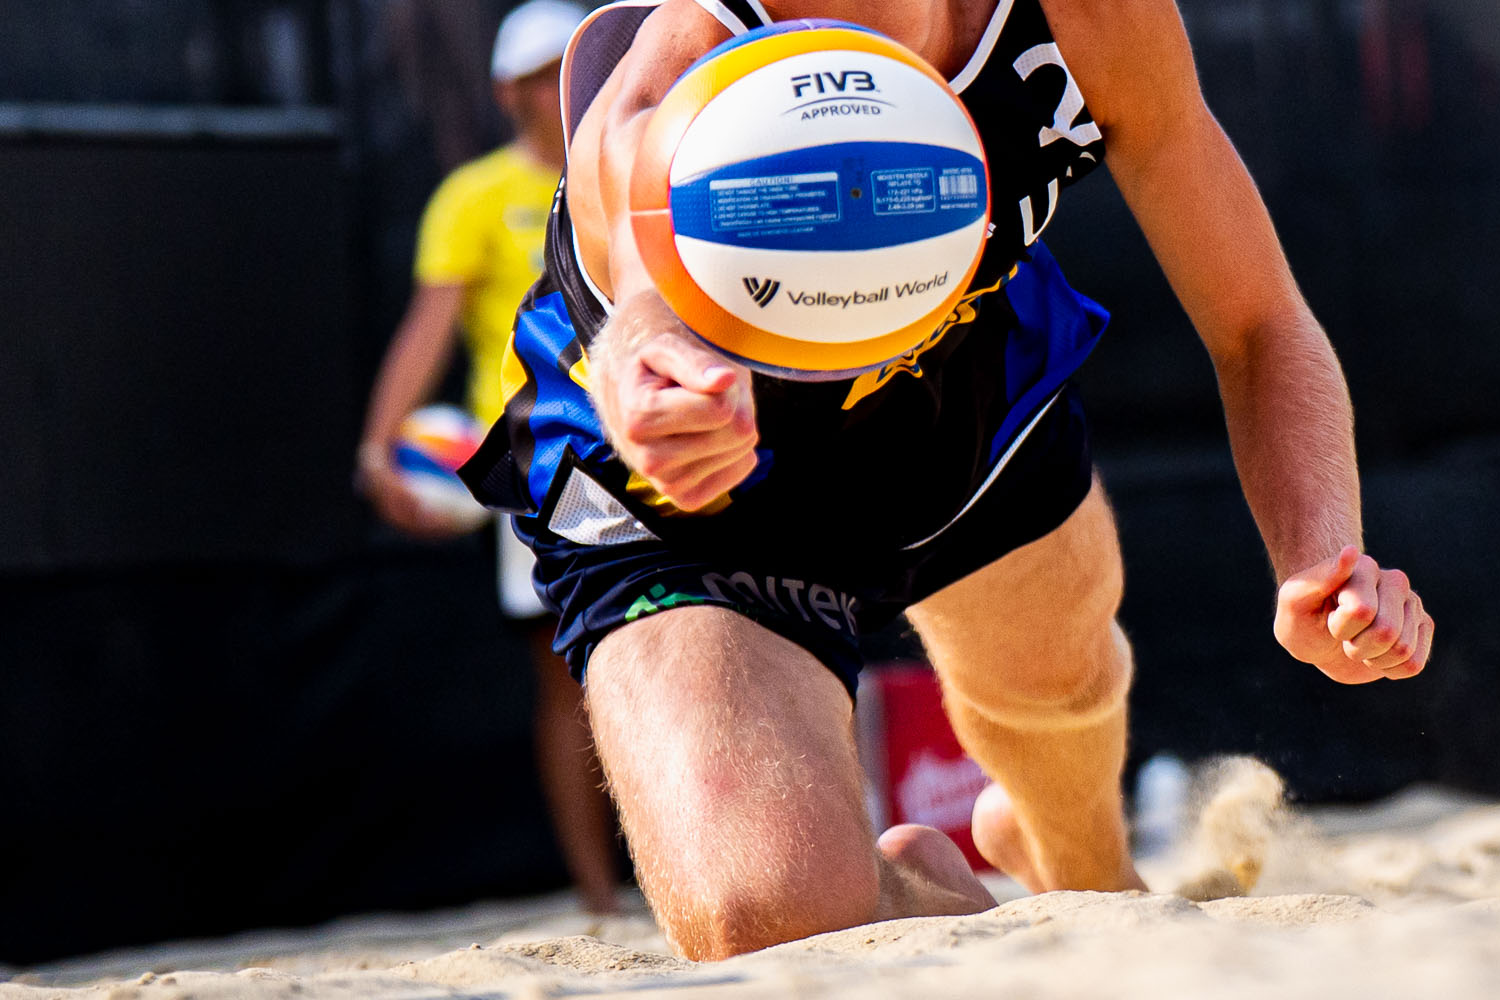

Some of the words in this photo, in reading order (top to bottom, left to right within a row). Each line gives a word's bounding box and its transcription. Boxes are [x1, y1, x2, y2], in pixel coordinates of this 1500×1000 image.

[791, 71, 876, 98] FIVB
[1013, 42, 1102, 147] 2
[801, 104, 881, 121] APPROVED
[787, 287, 889, 309] Volleyball
[895, 271, 948, 299] World
